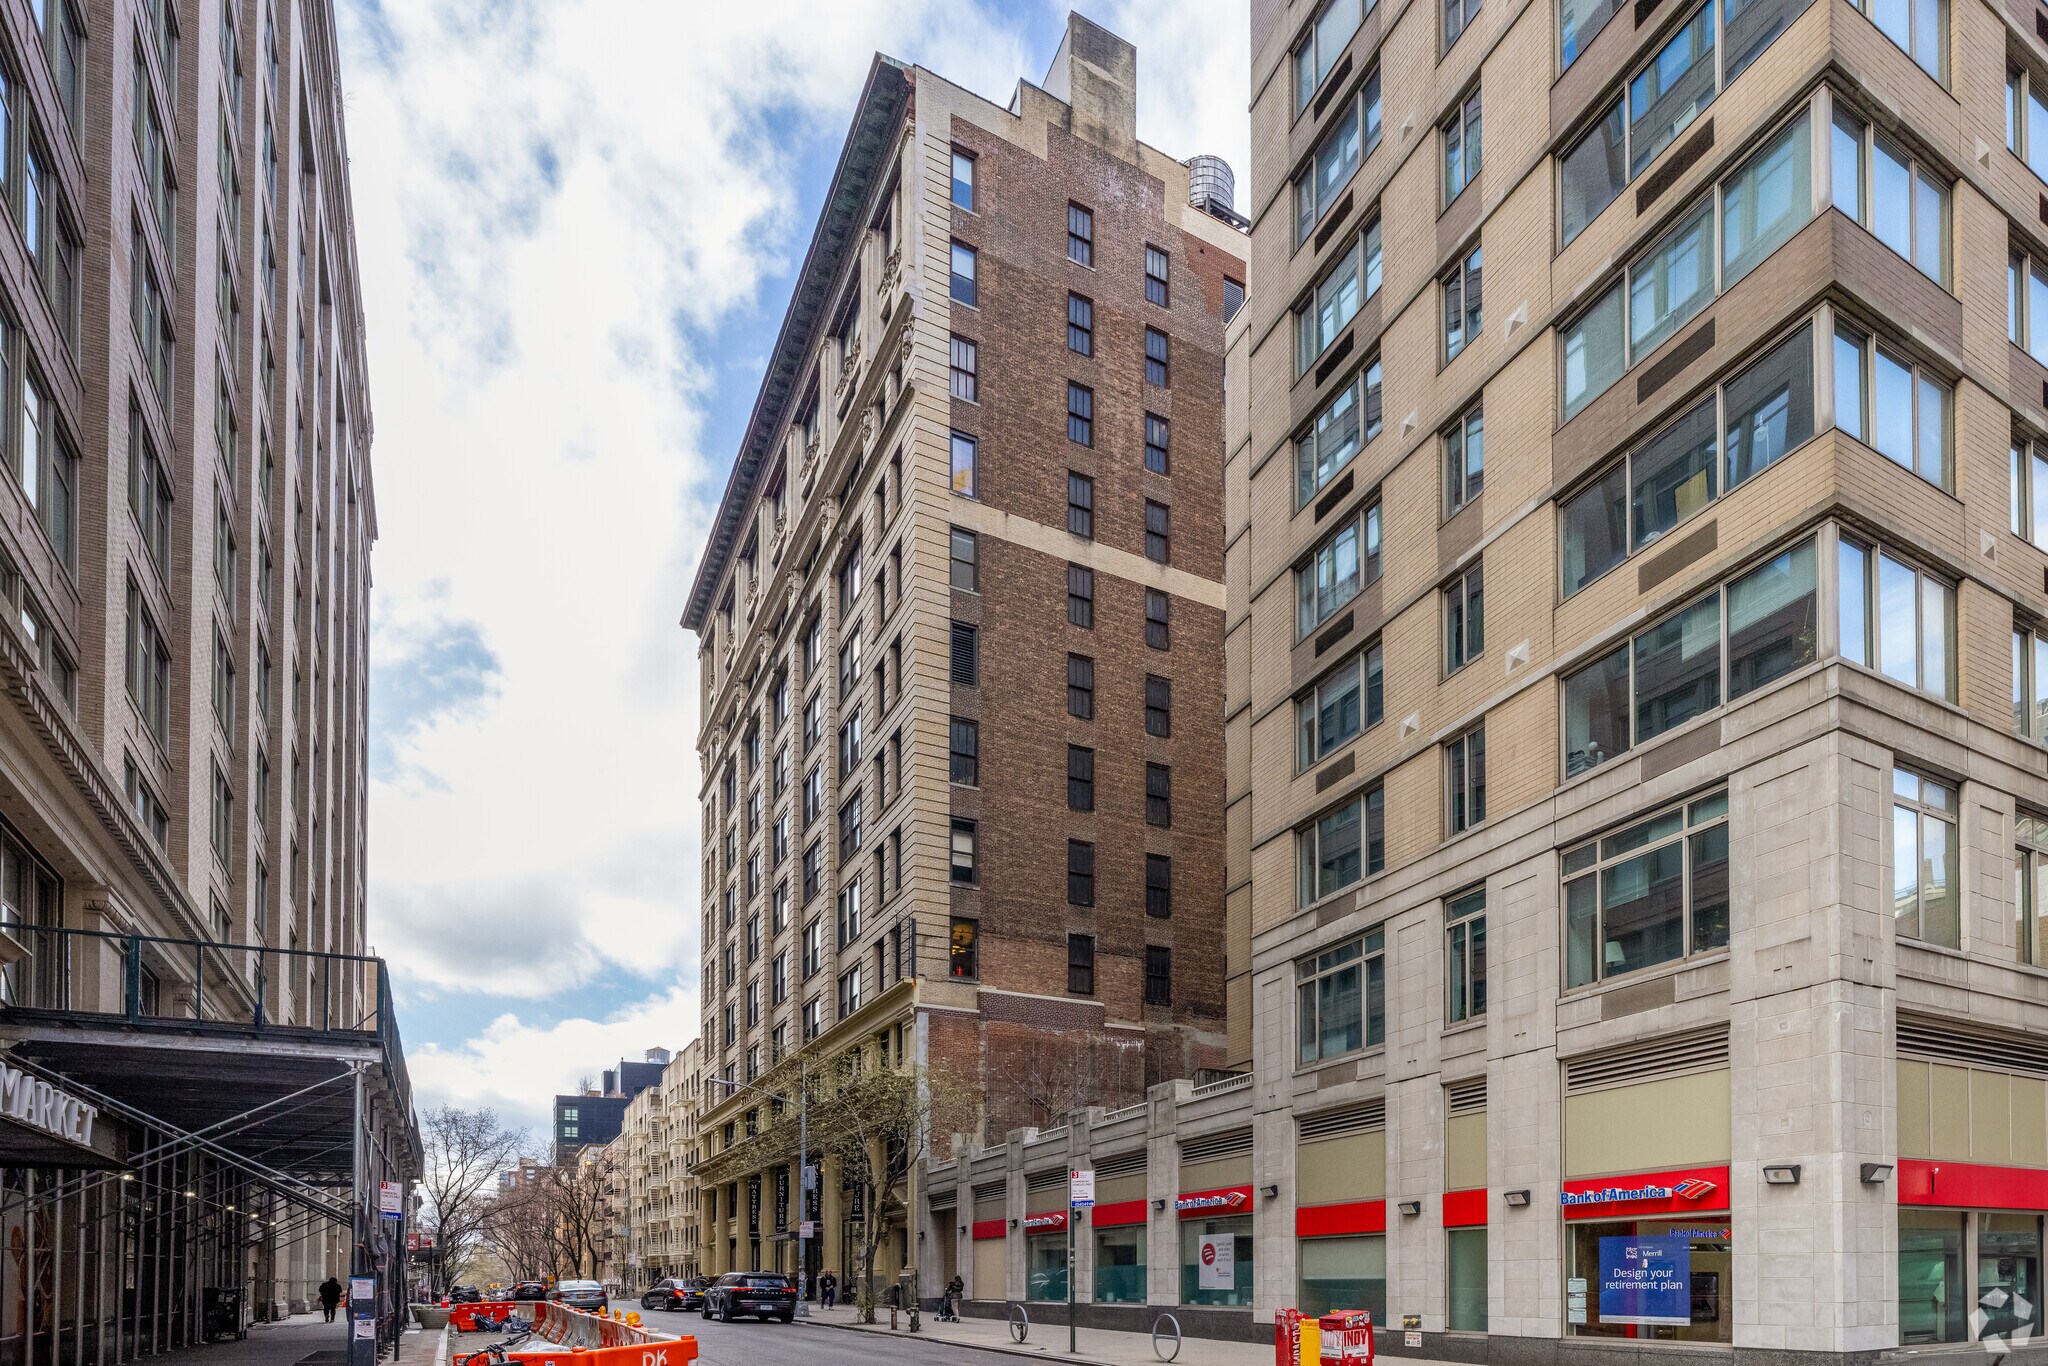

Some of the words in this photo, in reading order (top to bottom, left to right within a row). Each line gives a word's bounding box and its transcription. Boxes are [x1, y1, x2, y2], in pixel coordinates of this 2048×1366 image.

[0, 1061, 98, 1147] MARKET
[1174, 1199, 1189, 1210] Bank
[1189, 1198, 1196, 1208] of
[1196, 1196, 1223, 1207] America
[1560, 1190, 1592, 1205] Bank
[1593, 1188, 1607, 1202] of
[1608, 1185, 1666, 1201] America
[750, 1183, 758, 1225] MATTRESS
[1669, 1228, 1686, 1238] Bank
[1692, 1229, 1719, 1238] America
[1613, 1268, 1648, 1280] Design
[1650, 1269, 1673, 1280] your
[1605, 1280, 1658, 1290] retirement
[1660, 1279, 1683, 1292] plan
[1344, 1329, 1367, 1347] INDY
